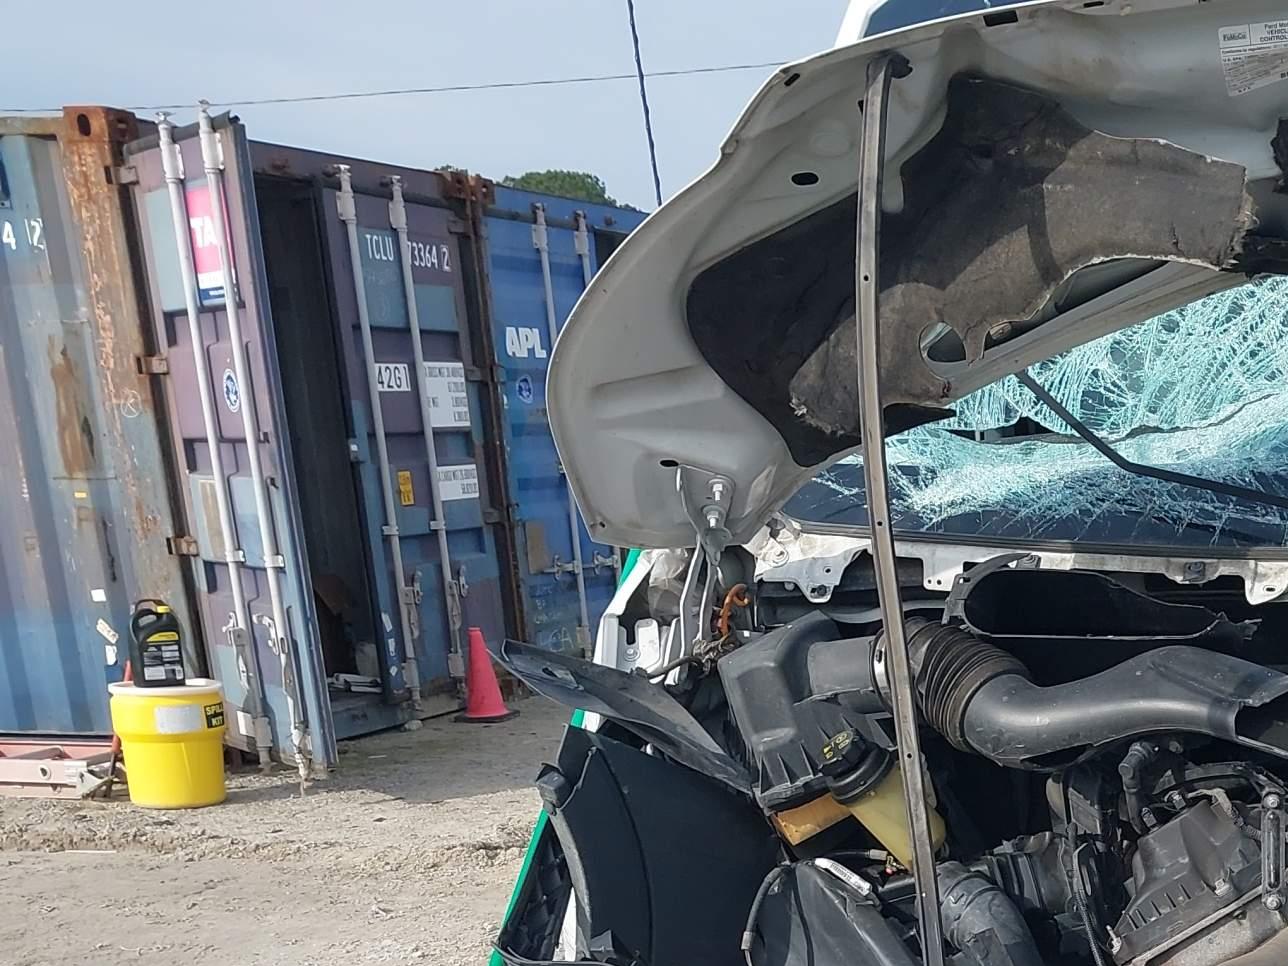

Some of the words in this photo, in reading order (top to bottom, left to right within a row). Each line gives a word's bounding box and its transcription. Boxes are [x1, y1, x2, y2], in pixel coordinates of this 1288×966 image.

[3, 221, 16, 250] 4
[364, 233, 394, 261] TCLU
[506, 327, 546, 358] APL
[378, 366, 410, 389] 42G1
